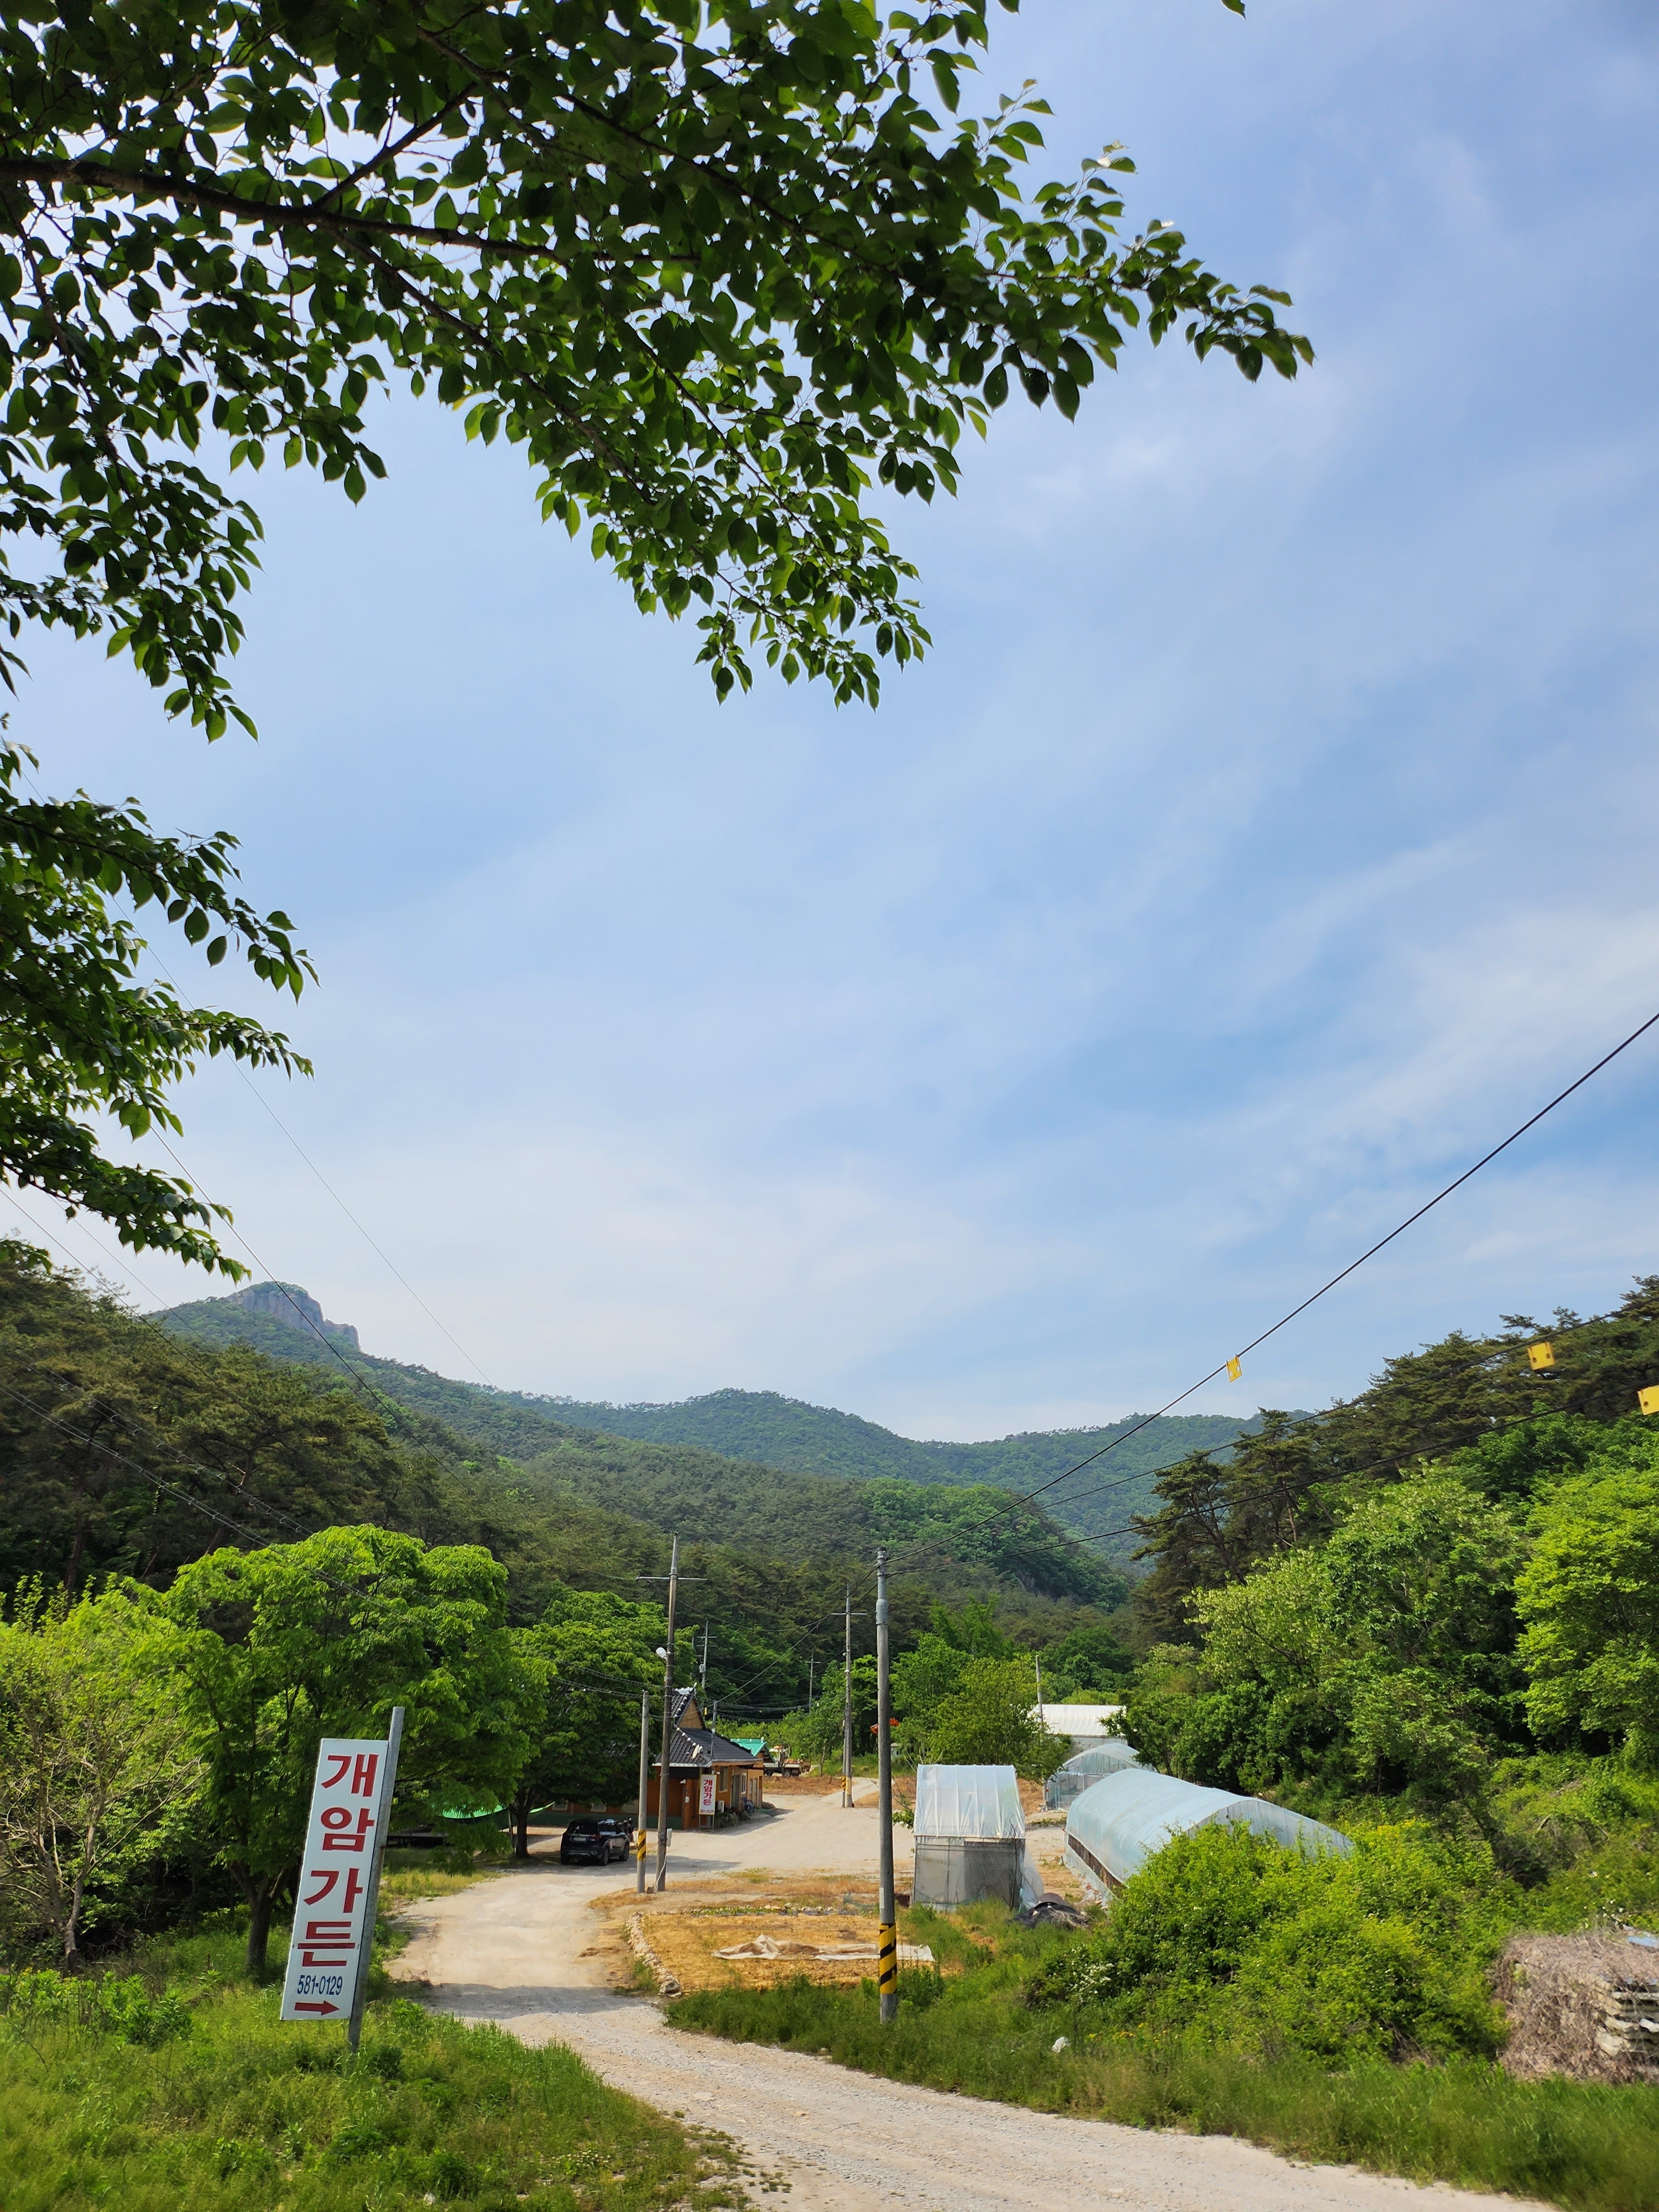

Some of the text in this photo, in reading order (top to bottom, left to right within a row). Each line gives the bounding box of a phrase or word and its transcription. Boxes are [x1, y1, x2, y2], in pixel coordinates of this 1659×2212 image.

[703, 1779, 713, 1806] 개암가든
[297, 1754, 379, 1967] 개암가든
[297, 1974, 343, 1995] 581-0129
